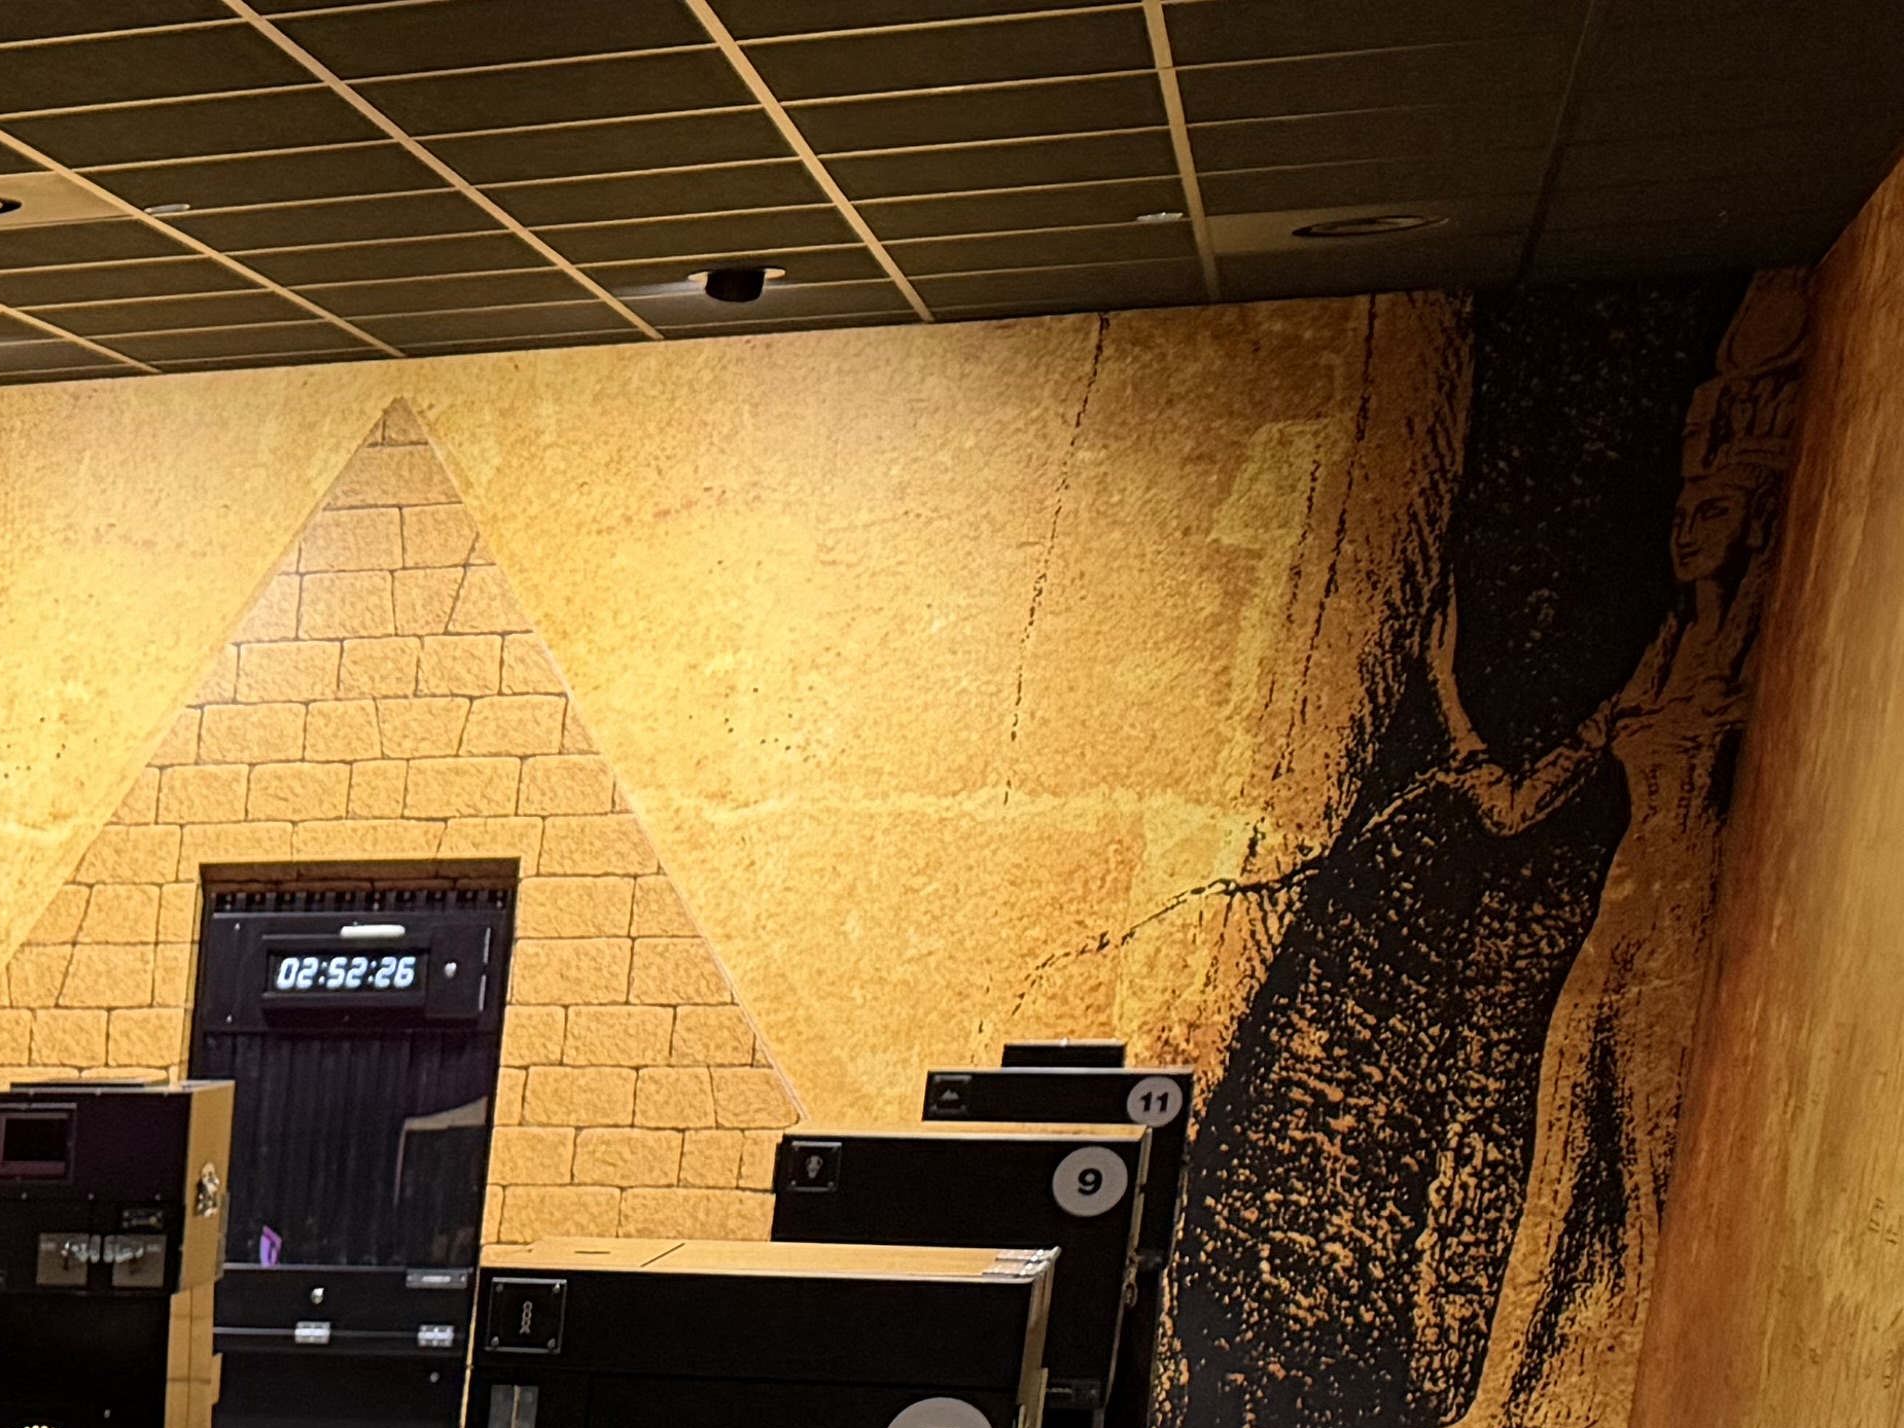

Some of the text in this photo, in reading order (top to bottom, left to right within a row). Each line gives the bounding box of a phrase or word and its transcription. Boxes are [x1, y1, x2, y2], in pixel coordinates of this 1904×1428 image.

[276, 956, 416, 989] 02:52:26
[1139, 1090, 1170, 1114] 11
[1077, 1167, 1103, 1196] 9
